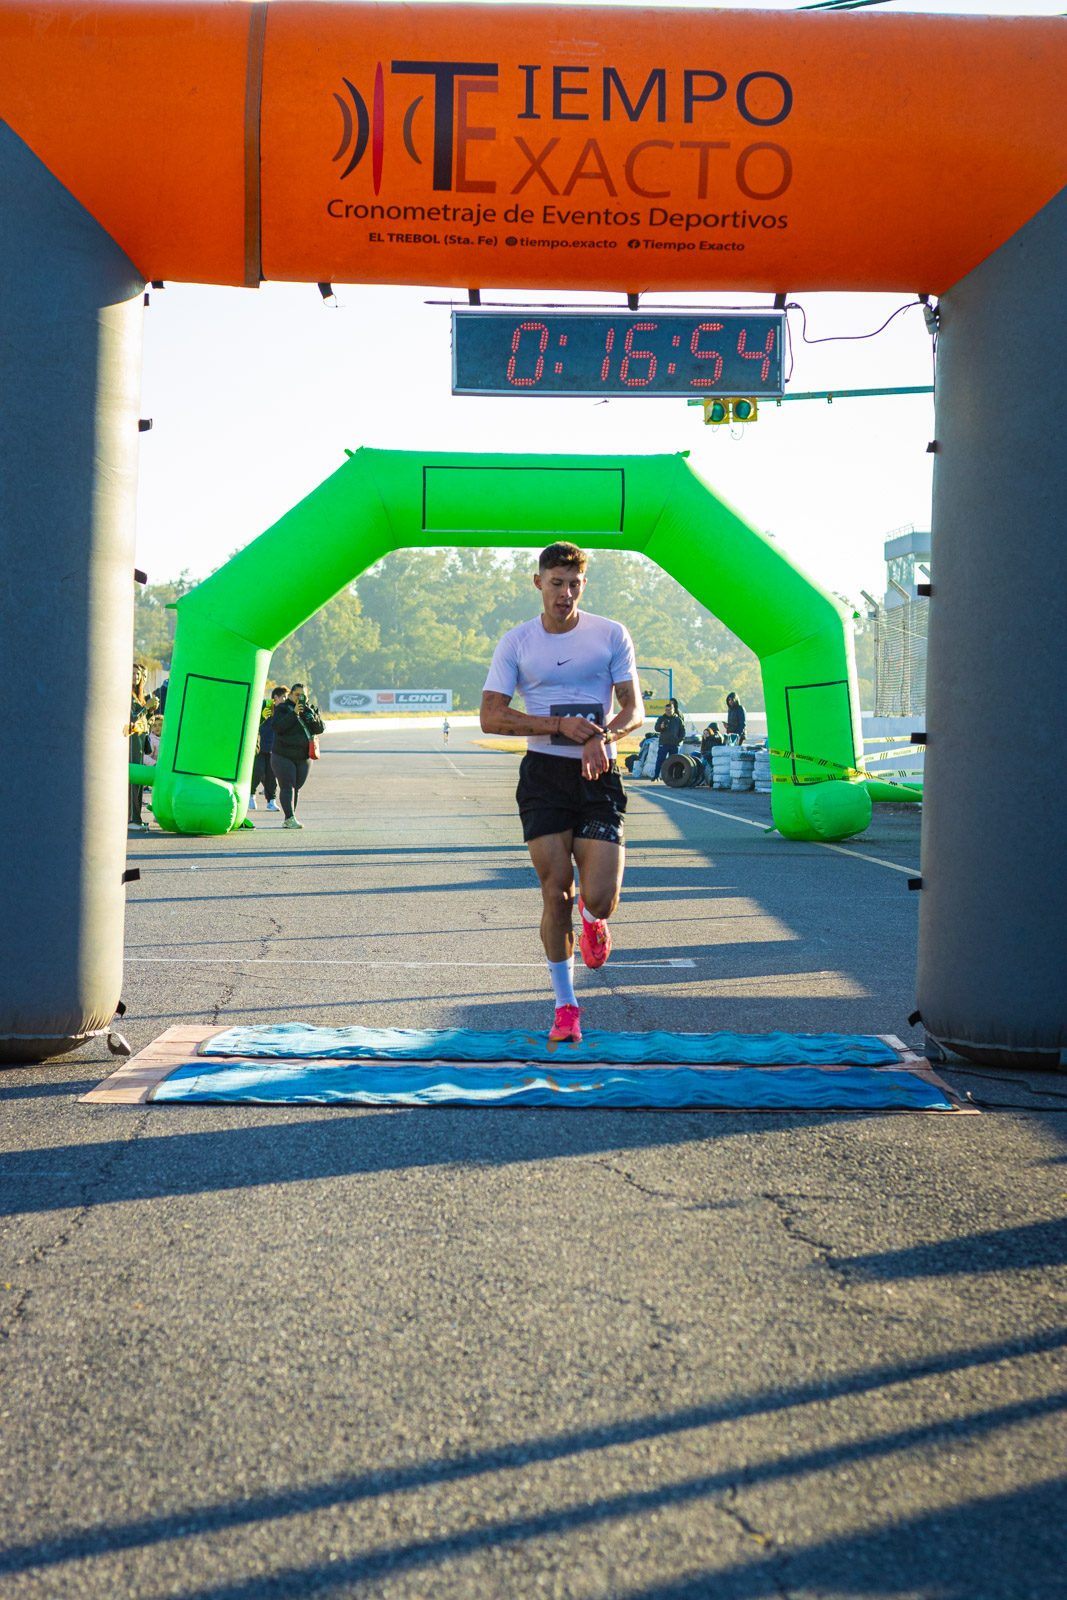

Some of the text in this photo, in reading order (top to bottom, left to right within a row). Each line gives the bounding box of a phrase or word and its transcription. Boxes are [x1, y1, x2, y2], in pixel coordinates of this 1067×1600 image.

[326, 199, 789, 232] Cronometraje de Eventos Deportivos
[368, 232, 498, 247] EL TREBOL (Sta. Fe)
[519, 237, 618, 250] tiempo.exacto
[643, 239, 745, 252] Tiempo Exacto
[340, 694, 364, 706] Ford
[398, 694, 443, 702] LONG
